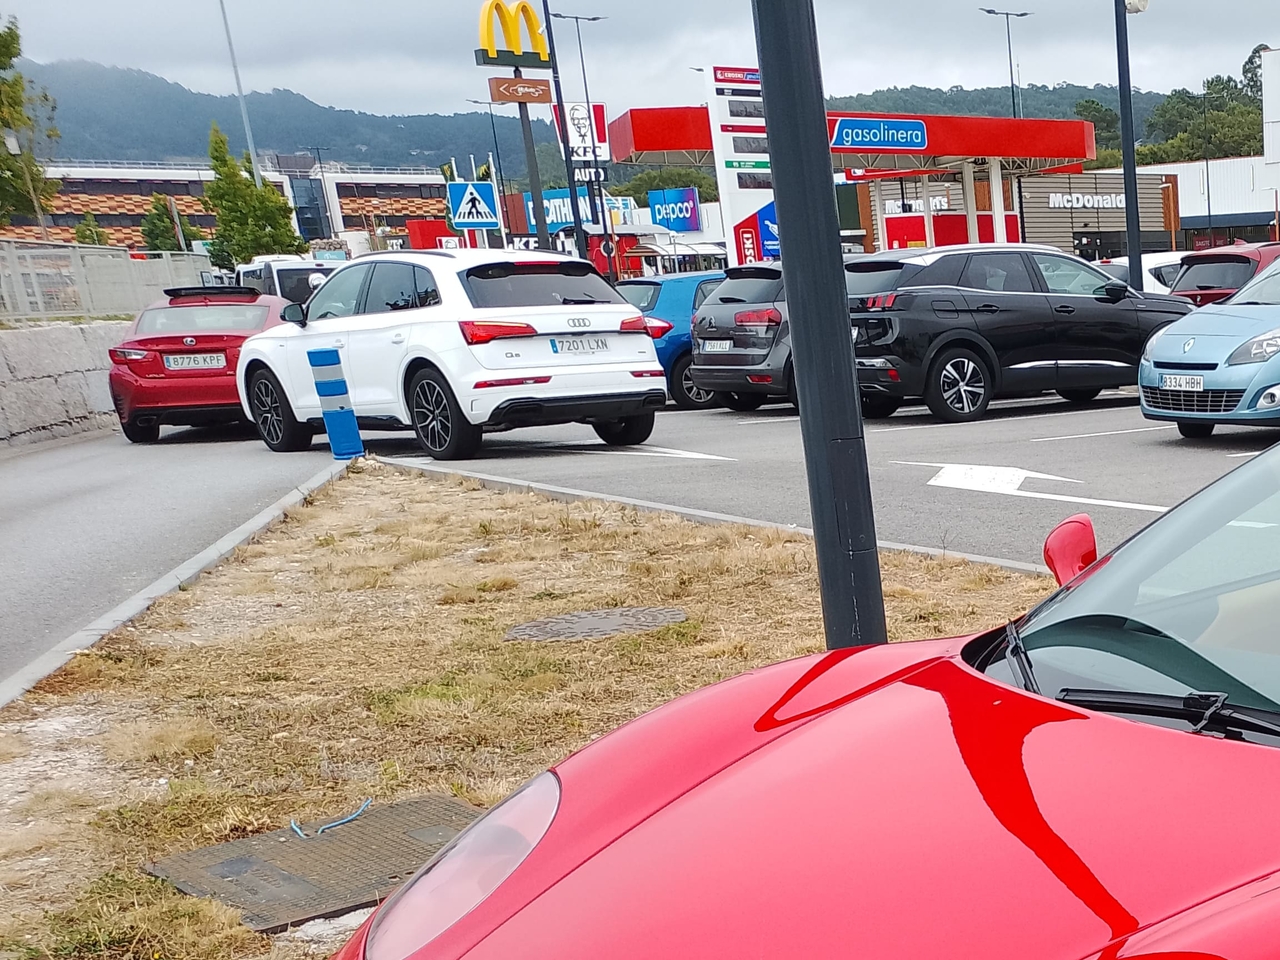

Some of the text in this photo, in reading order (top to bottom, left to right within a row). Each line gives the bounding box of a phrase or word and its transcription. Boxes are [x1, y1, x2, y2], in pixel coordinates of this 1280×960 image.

[843, 122, 922, 145] gasolinera
[570, 146, 602, 157] KFC
[1049, 193, 1126, 208] McDonald
[512, 238, 539, 249] KF
[742, 233, 756, 263] OSKI
[558, 338, 608, 351] 7201 LXN
[172, 355, 222, 366] 8776 KPF
[1163, 377, 1201, 389] 8334 HBH
